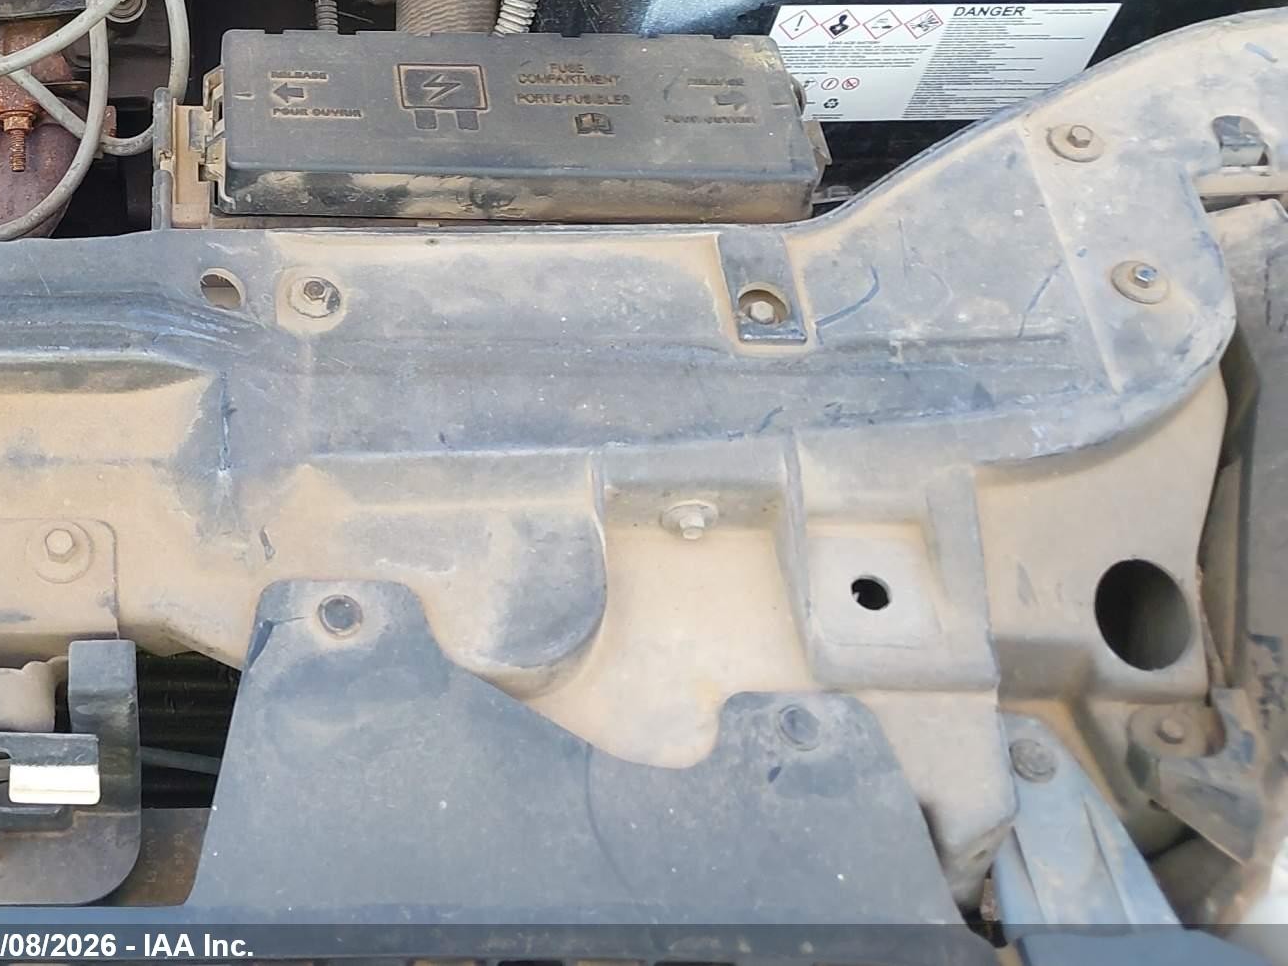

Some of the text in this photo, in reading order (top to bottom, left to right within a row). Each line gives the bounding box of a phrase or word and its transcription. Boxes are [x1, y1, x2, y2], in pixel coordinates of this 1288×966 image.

[952, 5, 1027, 18] DANGER
[549, 62, 586, 74] FUSE
[517, 73, 621, 86] COMPARTMENT
[515, 92, 633, 106] PORTE-FUSIBLES
[272, 107, 309, 118] POUR
